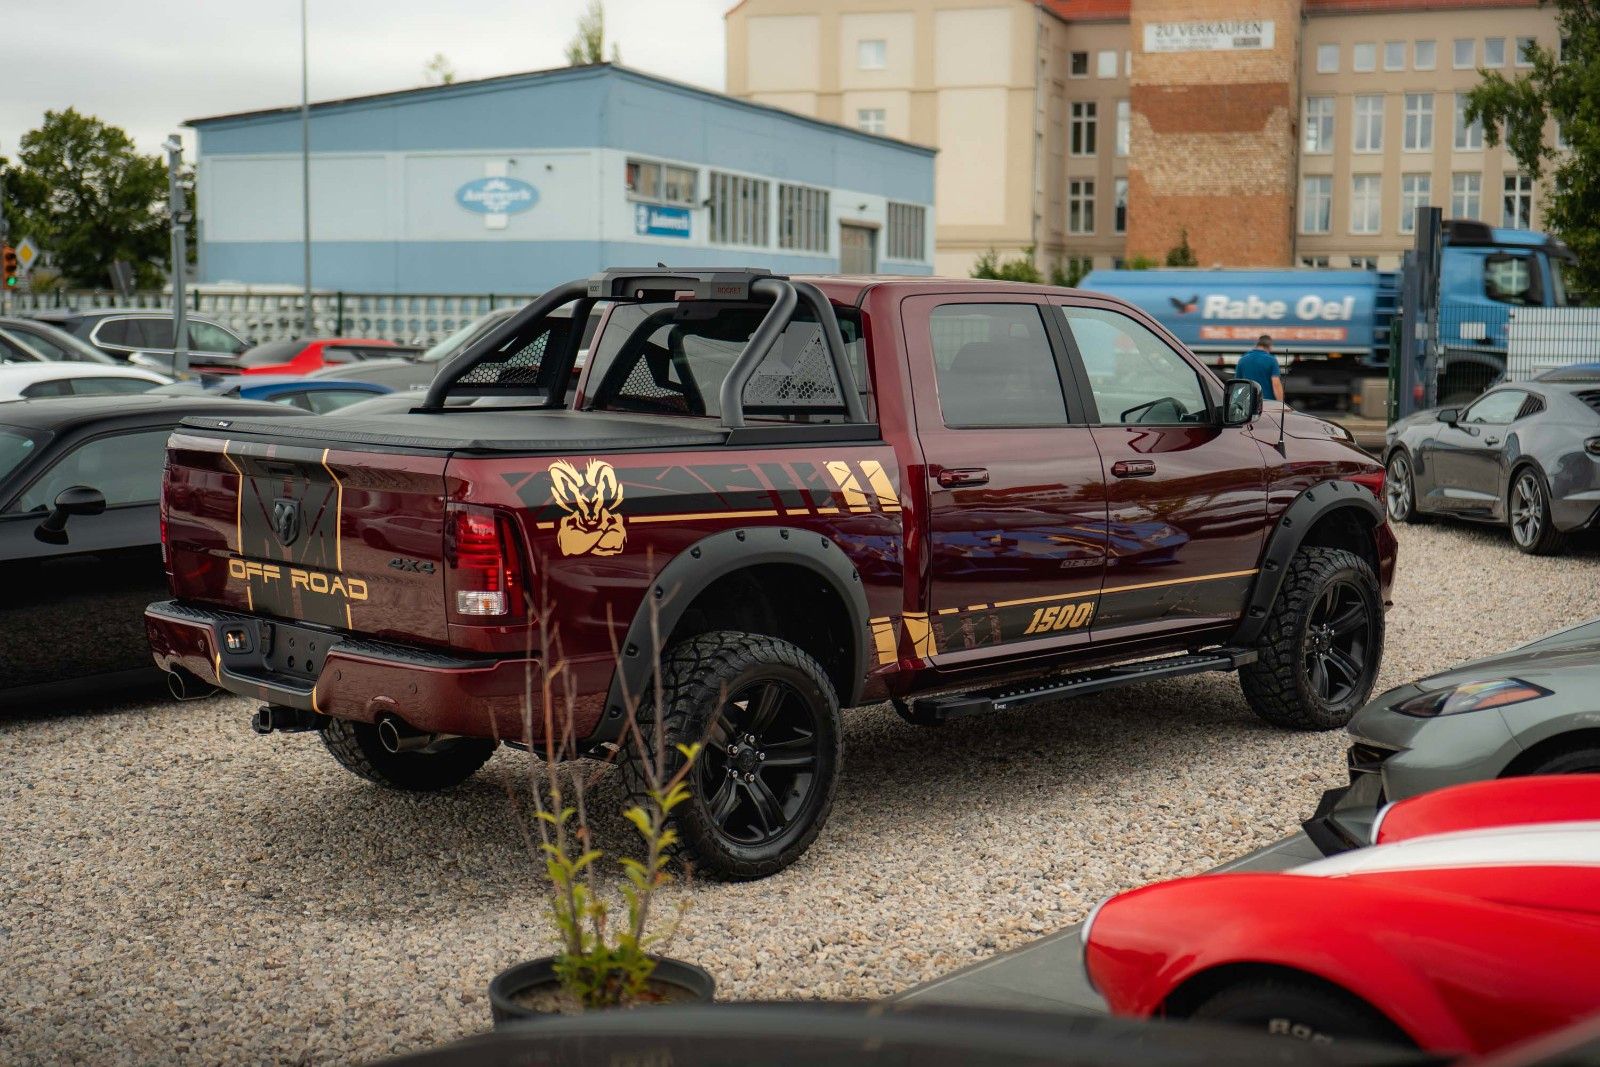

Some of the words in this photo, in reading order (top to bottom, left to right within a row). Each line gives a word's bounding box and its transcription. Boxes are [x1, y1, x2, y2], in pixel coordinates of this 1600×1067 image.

[1180, 23, 1263, 36] VERKAUFEN
[1201, 294, 1288, 320] Rabe
[1296, 294, 1356, 321] Oel
[228, 558, 281, 584] OFF
[290, 568, 369, 601] ROAD
[1023, 601, 1094, 635] 1500
